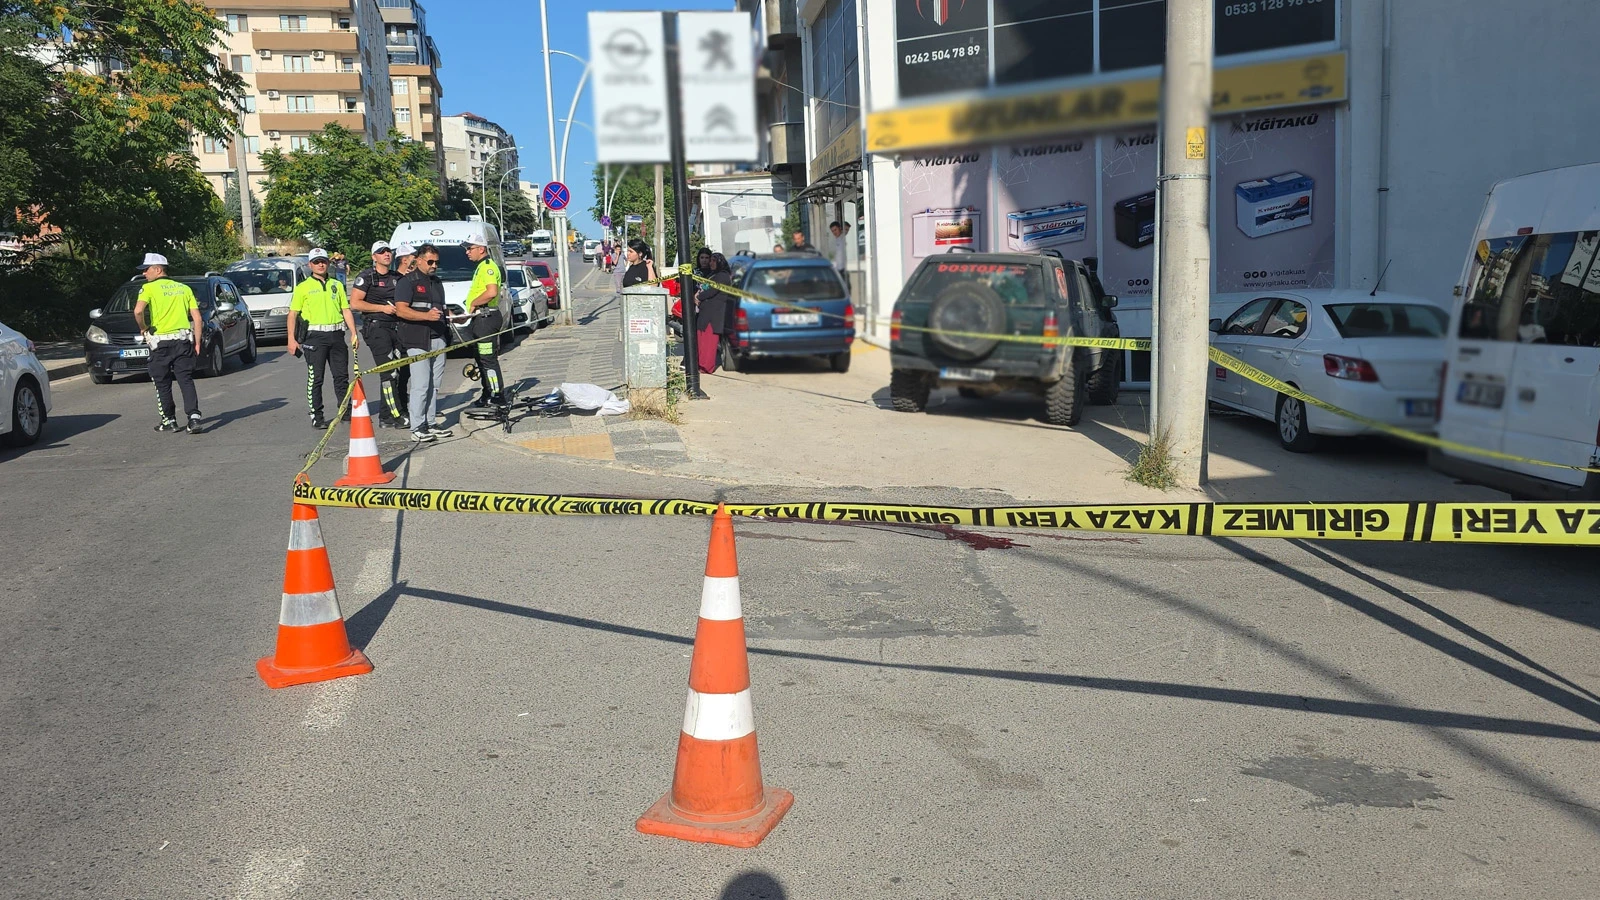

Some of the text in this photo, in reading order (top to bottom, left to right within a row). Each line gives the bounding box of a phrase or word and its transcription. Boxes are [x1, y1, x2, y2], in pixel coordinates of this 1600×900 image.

[1225, 2, 1257, 16] 0533
[1260, 0, 1284, 11] 128
[905, 45, 981, 65] 0262 504 78 89
[1245, 113, 1320, 132] YİĞİTAKÜ
[320, 487, 357, 503] KAZA
[494, 496, 539, 513] KAZA
[1086, 509, 1181, 530] KAZA
[1223, 508, 1390, 537] GİRİLMEZ
[1452, 508, 1547, 539] YERİ
